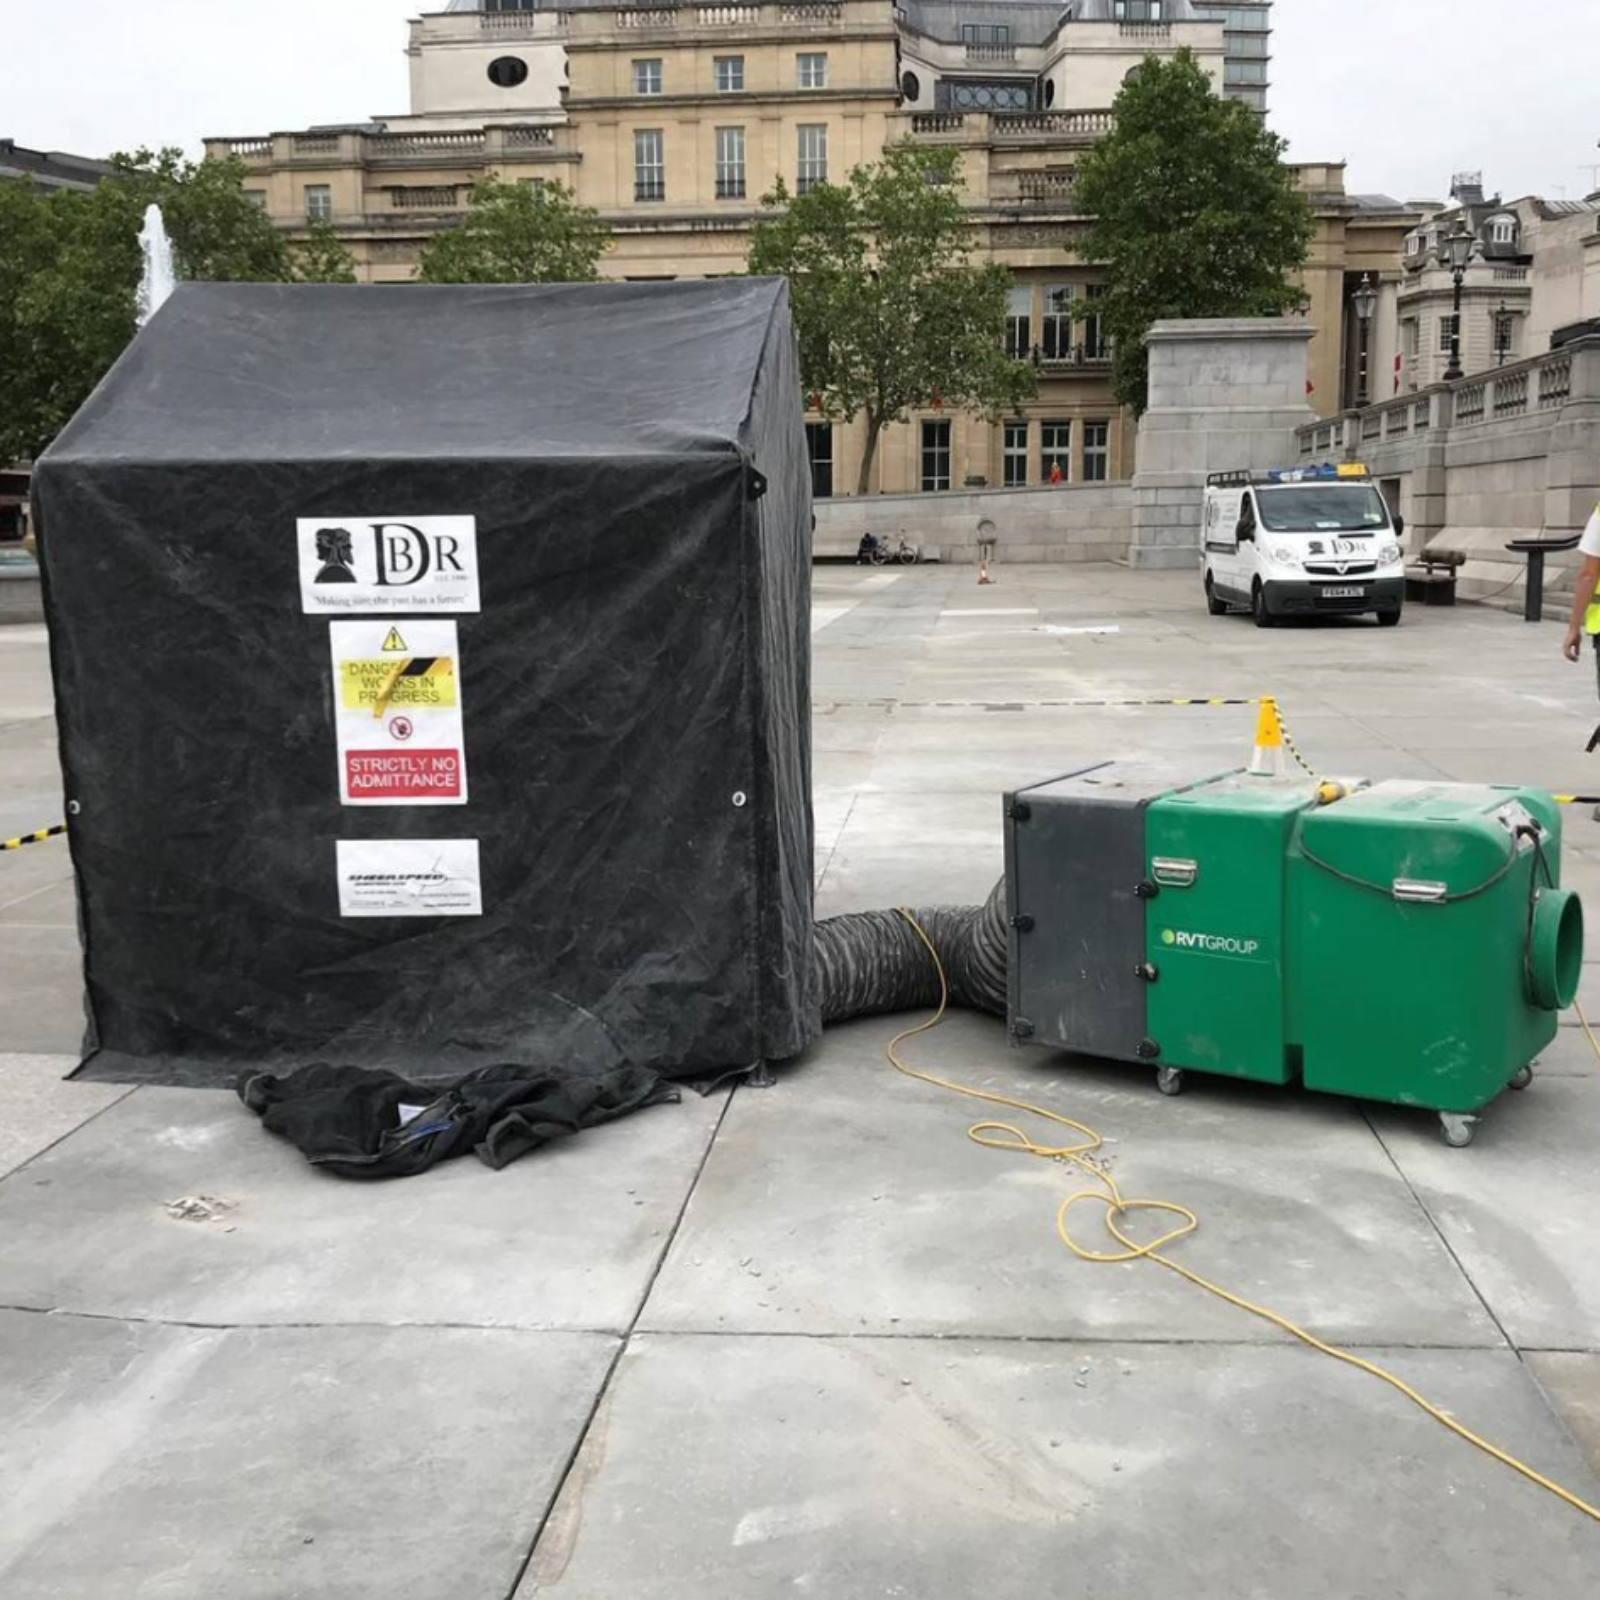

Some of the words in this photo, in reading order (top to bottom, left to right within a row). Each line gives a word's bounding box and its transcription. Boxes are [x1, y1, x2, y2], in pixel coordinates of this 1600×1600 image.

[368, 523, 464, 587] DBR
[361, 675, 417, 689] WOKS
[420, 675, 435, 689] IN
[358, 690, 441, 704] PRGRESS
[349, 756, 429, 773] STRICTLY
[431, 756, 457, 772] NO
[351, 772, 457, 789] ADMITTANCE
[1175, 931, 1258, 955] RVTGROUP
